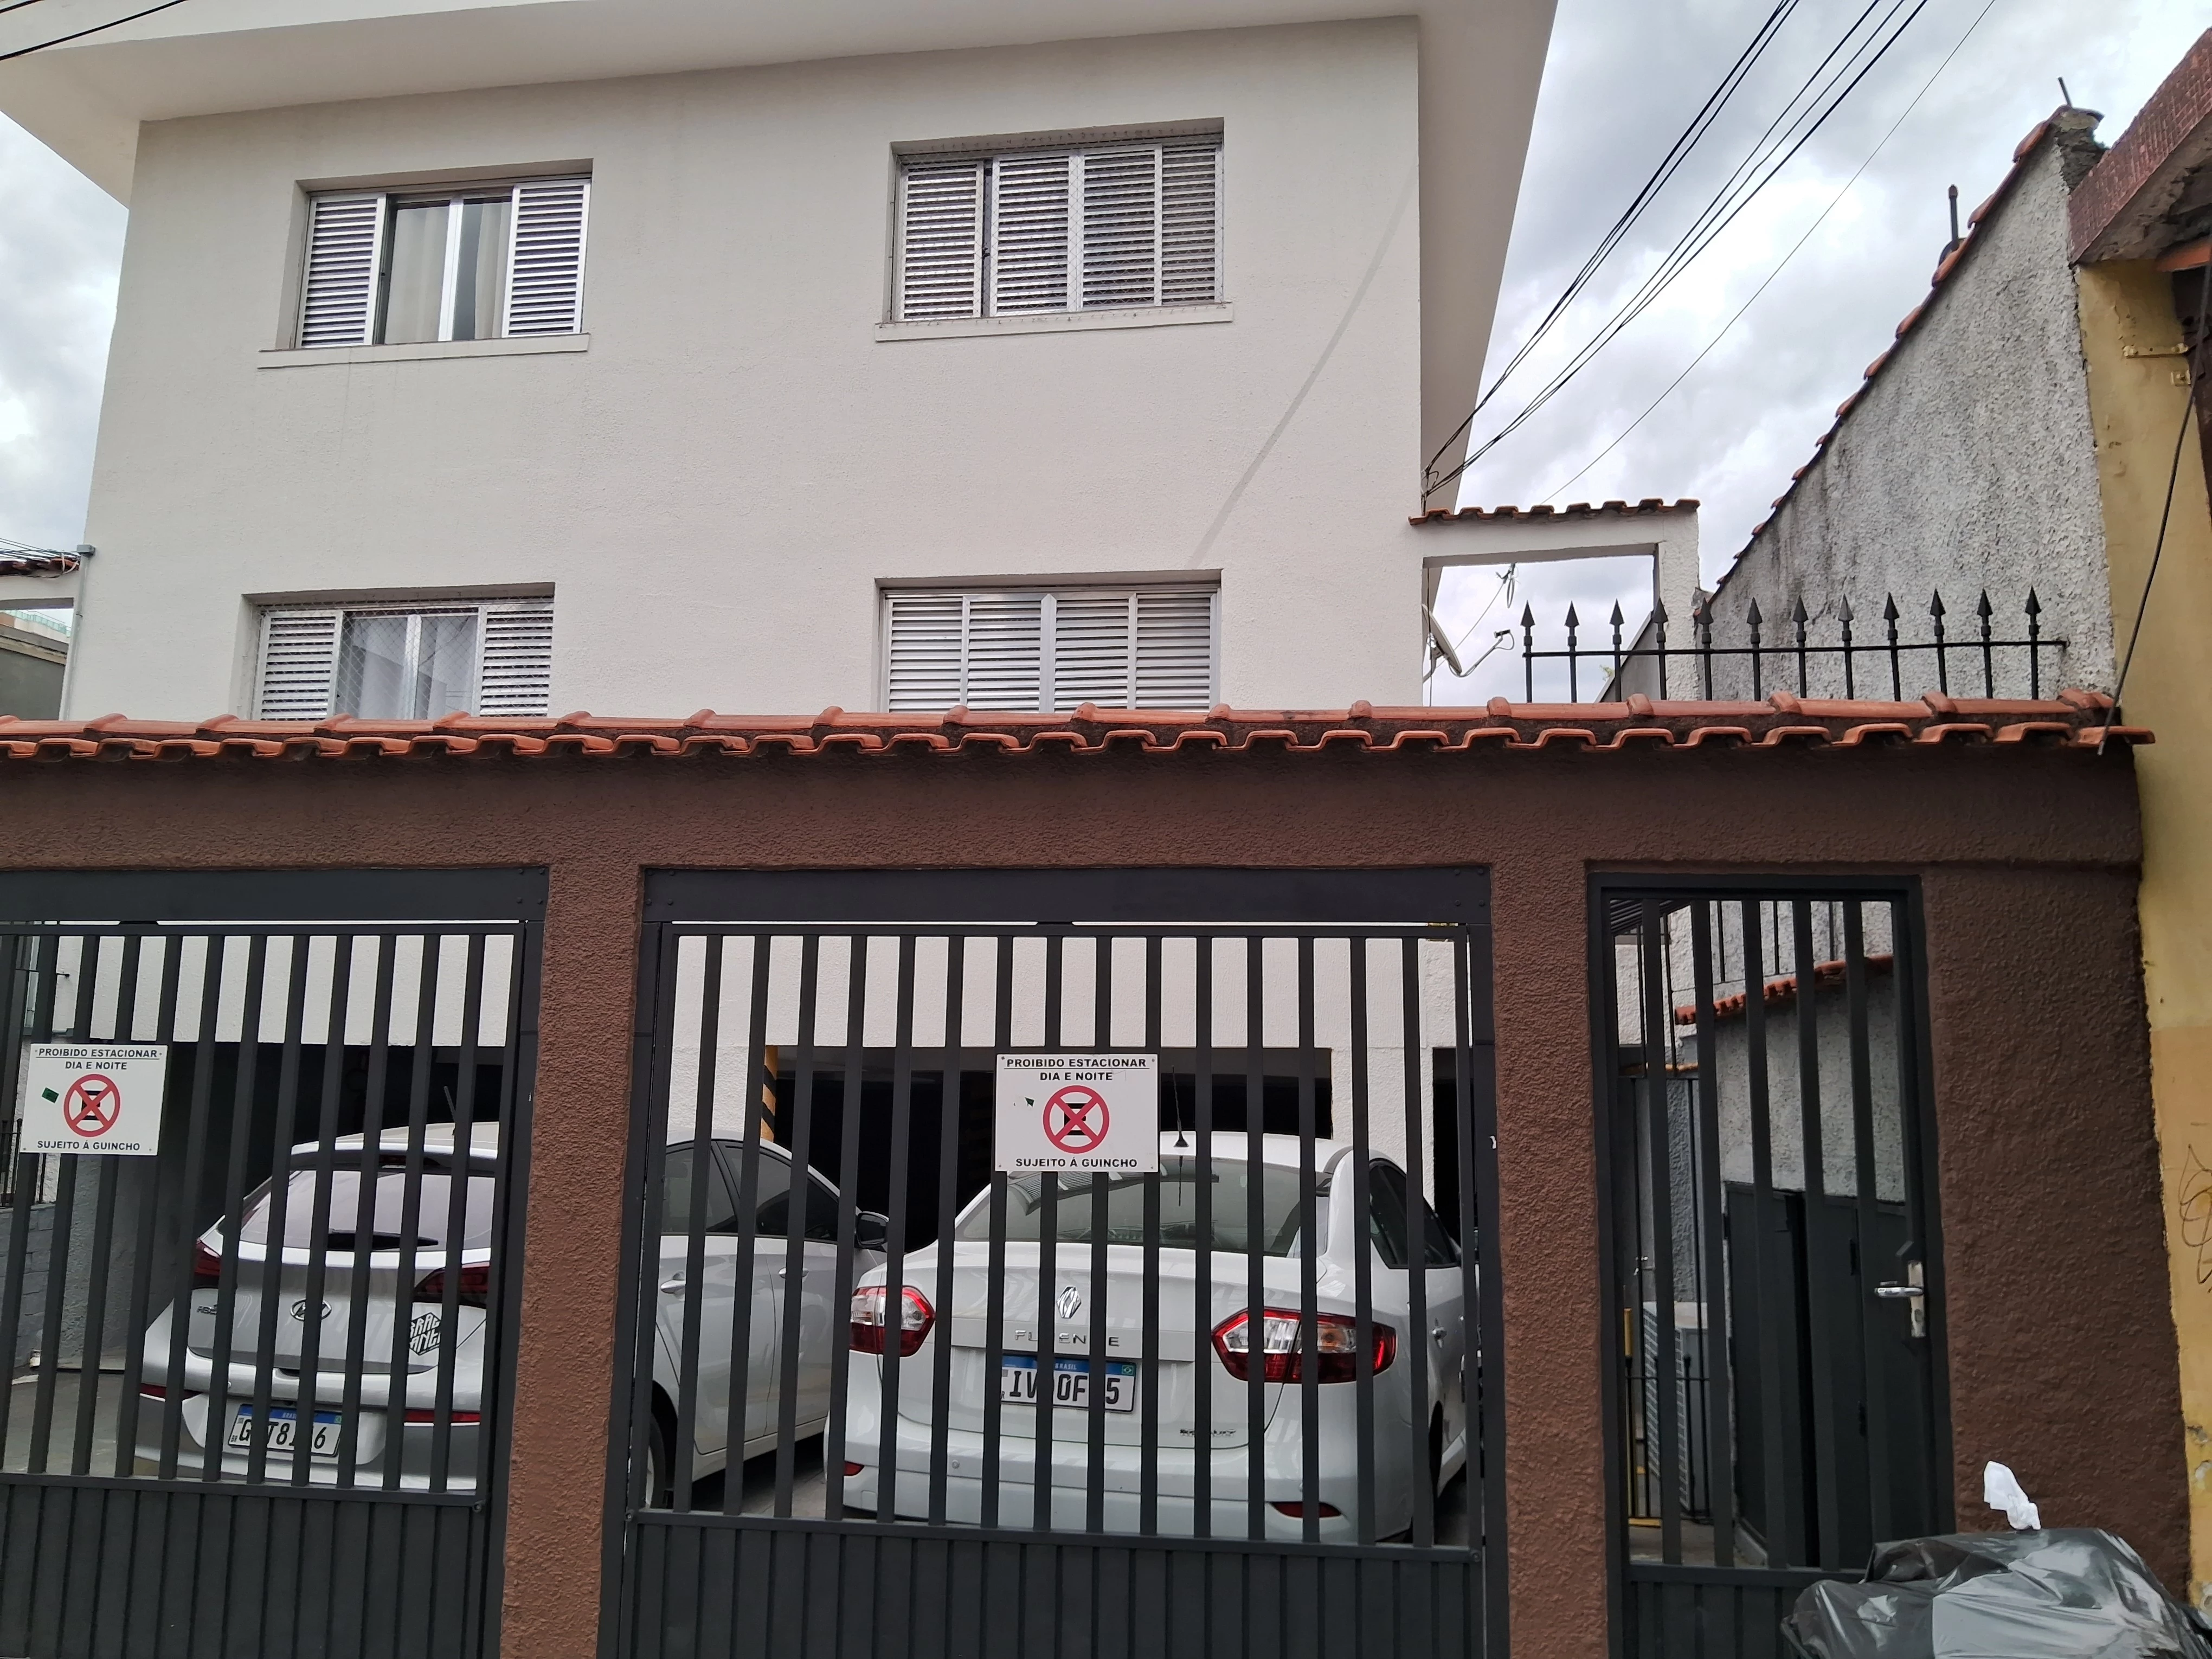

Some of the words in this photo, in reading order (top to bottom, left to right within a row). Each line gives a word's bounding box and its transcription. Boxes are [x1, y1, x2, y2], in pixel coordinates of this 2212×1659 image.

[38, 1048, 88, 1057] PROIBIDO
[91, 1049, 157, 1057] ESTACIONAR
[65, 1061, 82, 1069] DIA
[1007, 1059, 1064, 1067] PROIBIDO
[1069, 1059, 1146, 1067] ESTACIONAR
[1040, 1072, 1060, 1081] DIA
[1064, 1072, 1071, 1081] E
[1076, 1072, 1113, 1081] NOITE
[37, 1140, 79, 1149] SUJEITO
[93, 1142, 140, 1150] GUINCHO
[1015, 1159, 1065, 1167] SUJEITO
[1082, 1159, 1137, 1167] GUINCHO
[1014, 1330, 1120, 1347] FLENE
[1009, 1371, 1121, 1404] IV0F5
[239, 1419, 326, 1449] GT86
